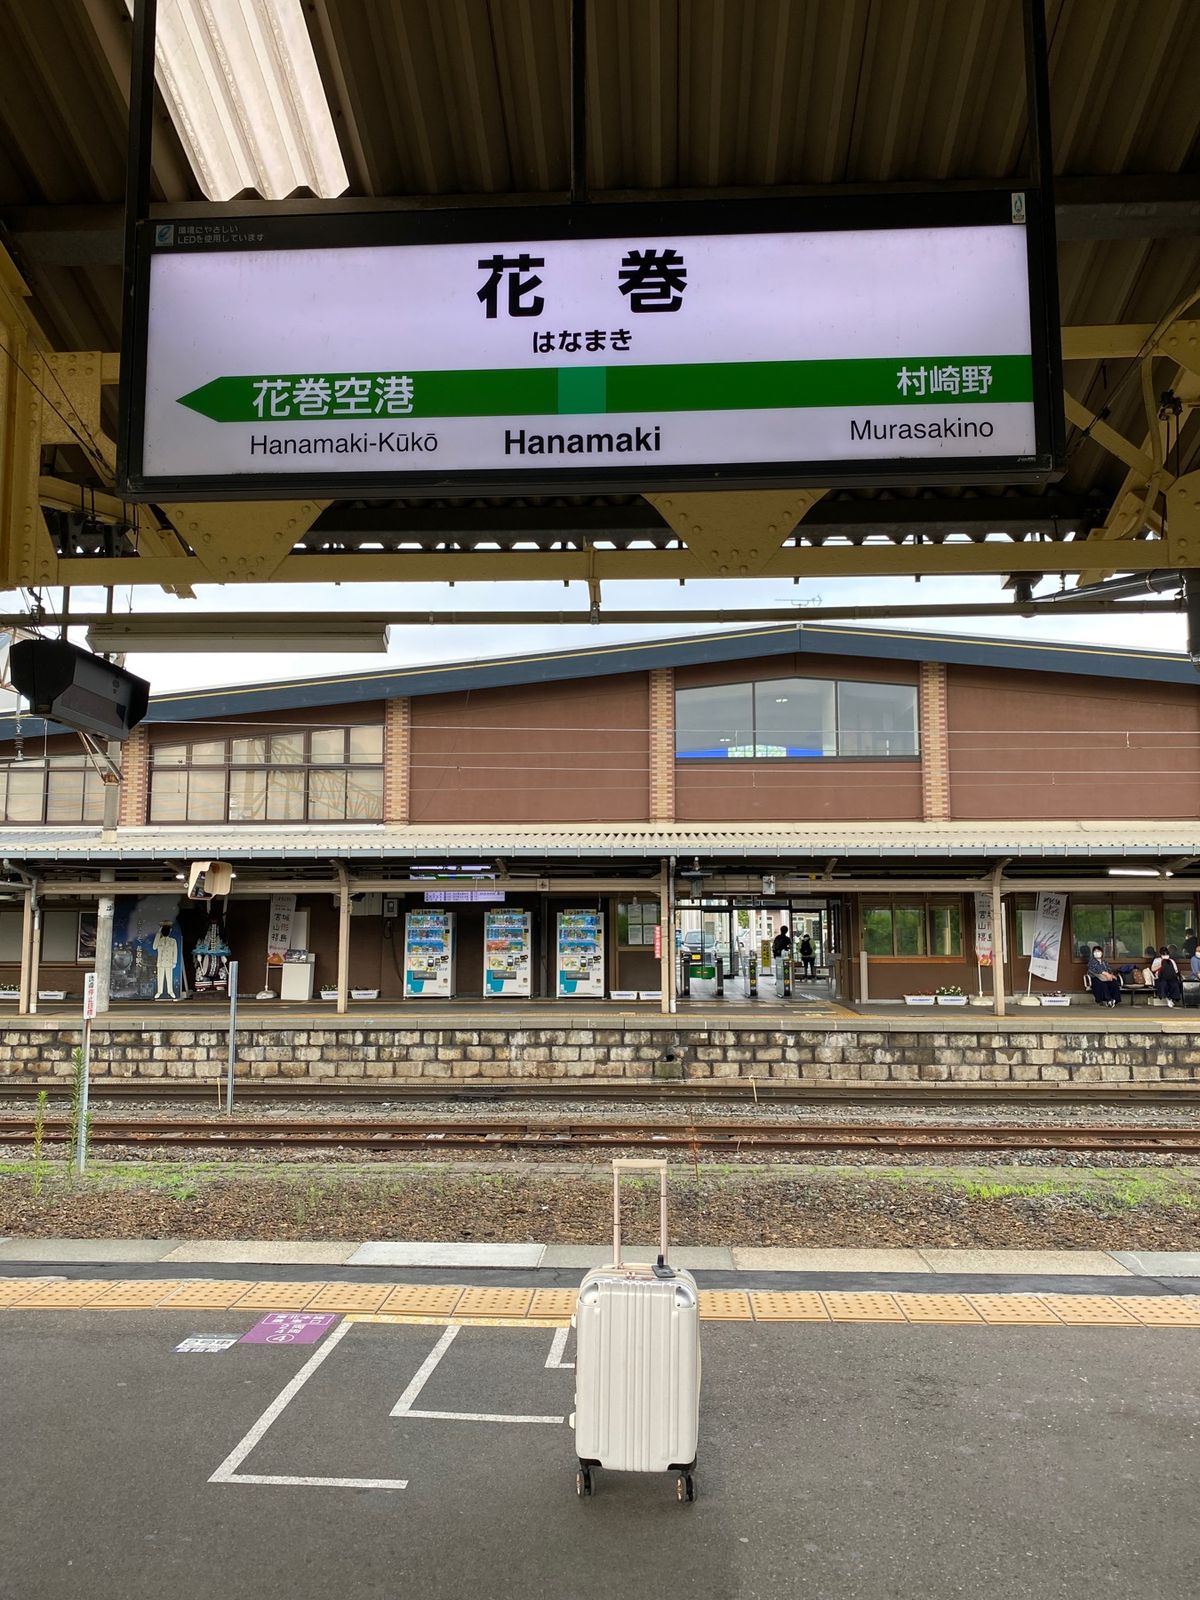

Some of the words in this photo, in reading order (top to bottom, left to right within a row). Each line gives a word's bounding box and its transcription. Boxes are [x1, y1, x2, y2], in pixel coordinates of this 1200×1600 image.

[177, 233, 265, 245] LEDを使用しています
[178, 225, 239, 235] 環境にやさしい
[476, 248, 688, 319] 花巻
[533, 329, 632, 353] はなまき
[896, 364, 994, 397] 村崎野
[252, 375, 415, 419] 花巻空港
[504, 425, 662, 455] Hanamaki
[850, 418, 994, 441] Murasakino
[250, 433, 438, 456] Hanamaki-Kūkō
